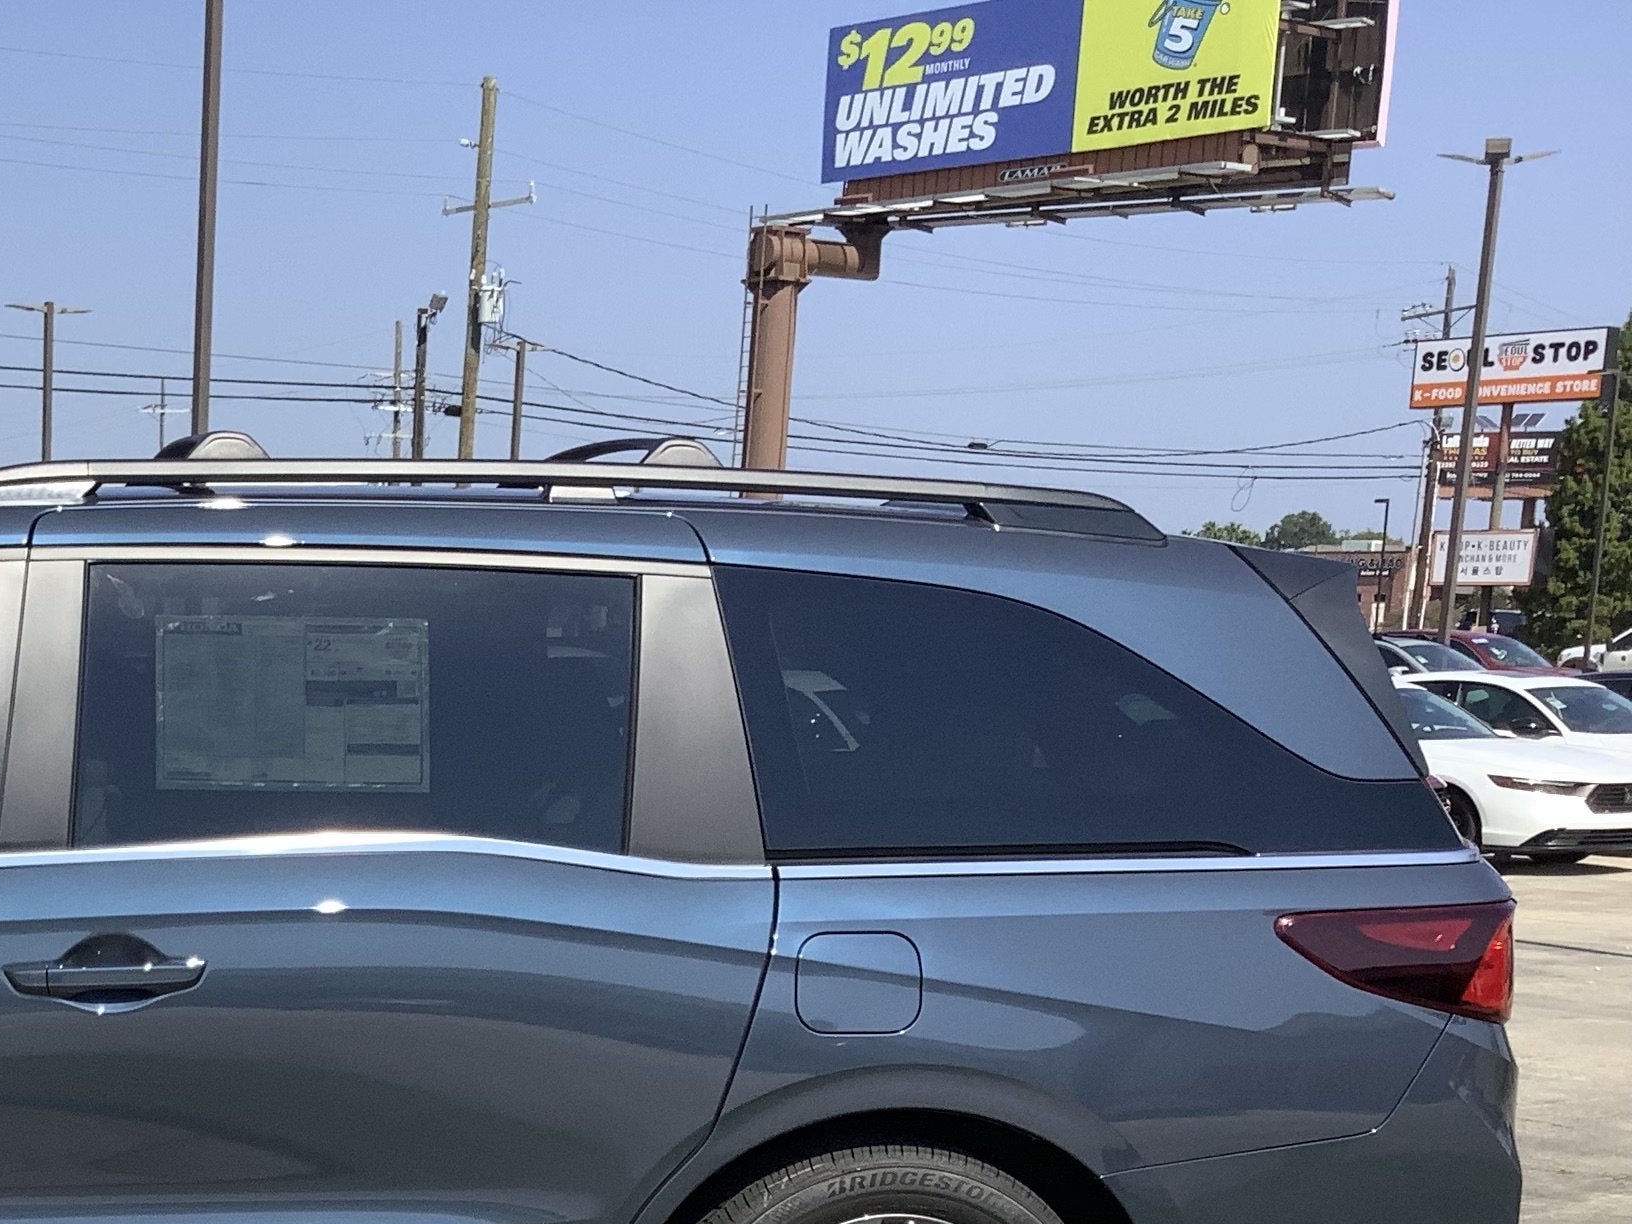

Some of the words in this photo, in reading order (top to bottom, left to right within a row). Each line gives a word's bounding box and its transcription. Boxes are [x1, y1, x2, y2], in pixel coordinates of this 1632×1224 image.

[1172, 6, 1204, 20] TAKE
[1163, 17, 1199, 53] 5
[925, 57, 971, 76] MONTHLY
[835, 64, 1056, 132] UNLIMITED
[1109, 81, 1191, 110] WORTH
[1197, 74, 1241, 97] THE
[1086, 107, 1158, 135] EXTRA
[1165, 104, 1181, 124] 2
[1186, 94, 1260, 121] MILES
[834, 111, 999, 169] WASHES
[1532, 340, 1599, 365] STOP
[1414, 386, 1463, 401] K-FOOD
[1555, 379, 1598, 393] STORE
[1520, 455, 1550, 463] ESTATE
[1477, 540, 1529, 552] K-BEAUTY
[1496, 554, 1517, 563] MORE
